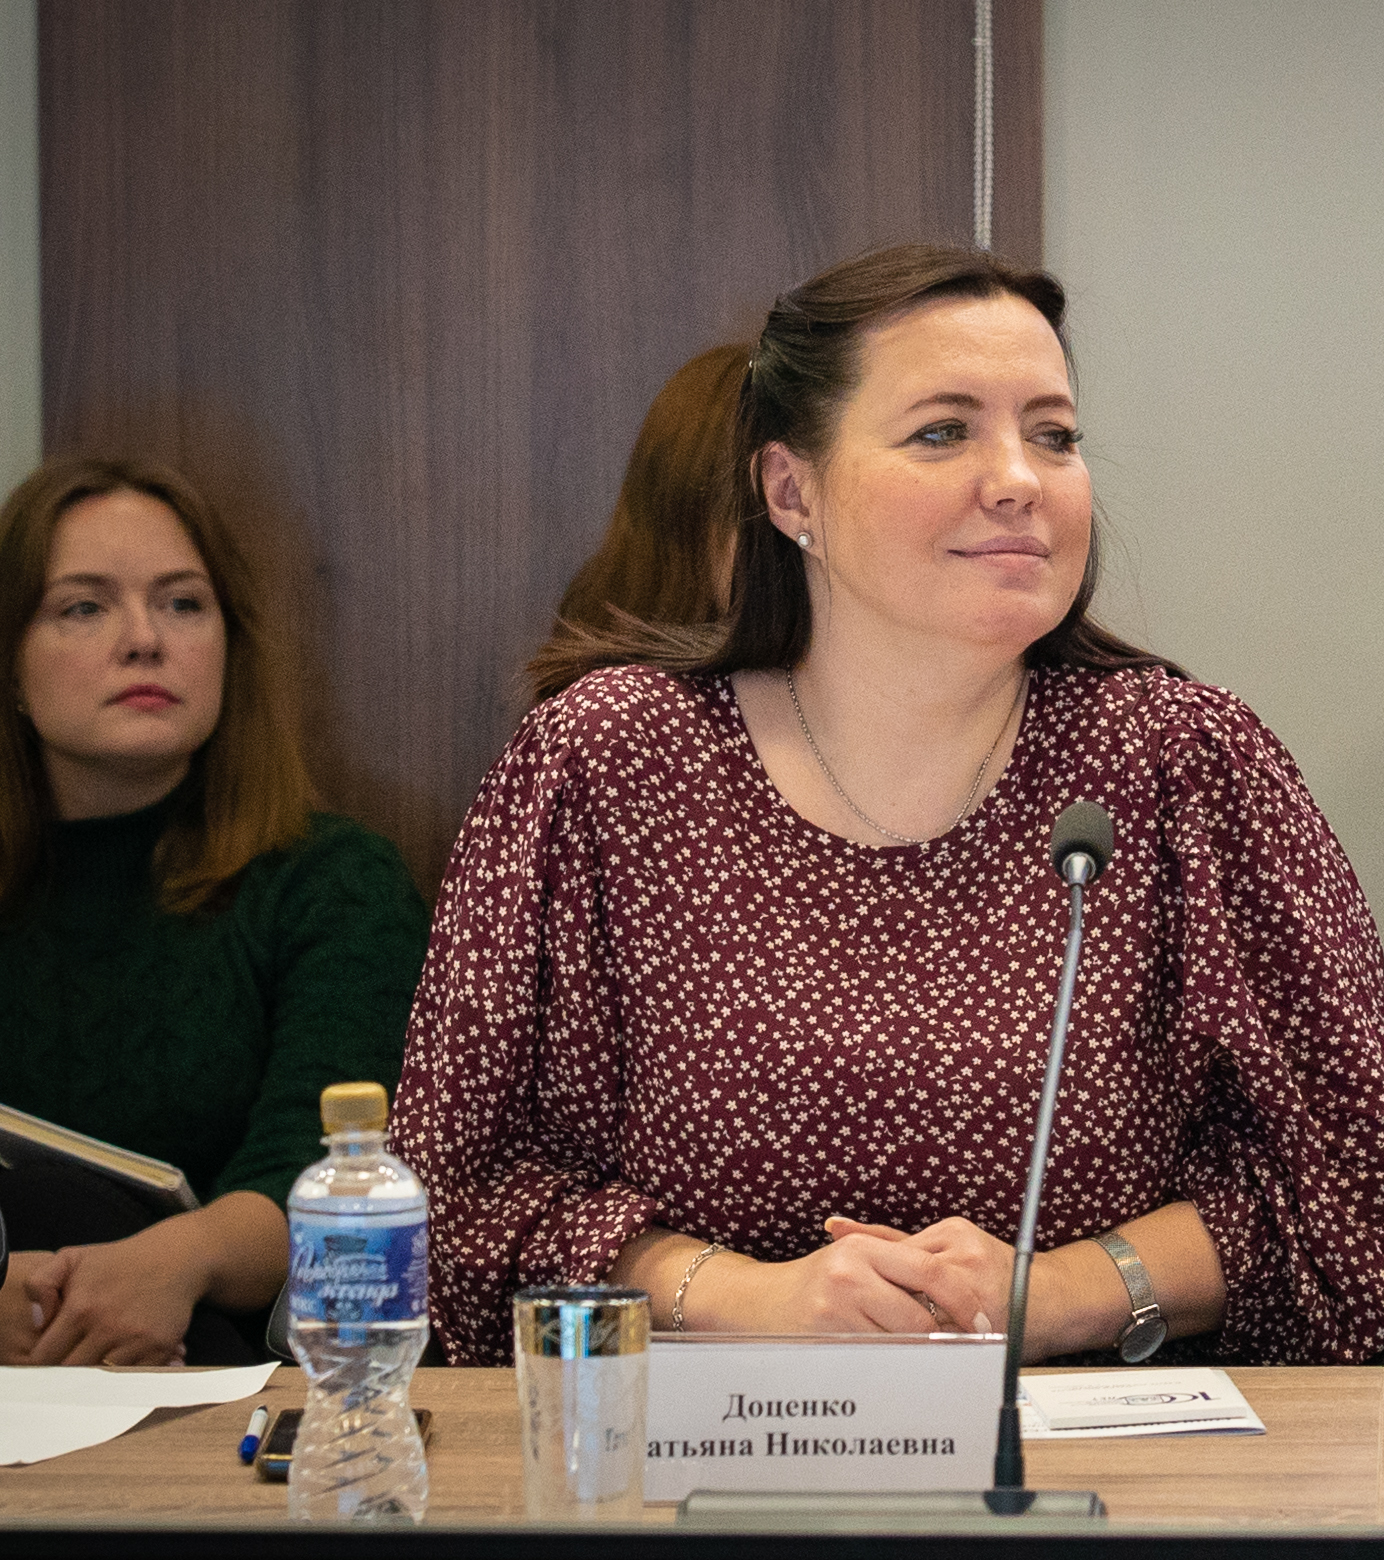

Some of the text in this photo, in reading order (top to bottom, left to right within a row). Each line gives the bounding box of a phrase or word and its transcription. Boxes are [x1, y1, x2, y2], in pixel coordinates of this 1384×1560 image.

[722, 1393, 857, 1422] Доценко
[647, 1431, 956, 1459] атьяна Николаевна
